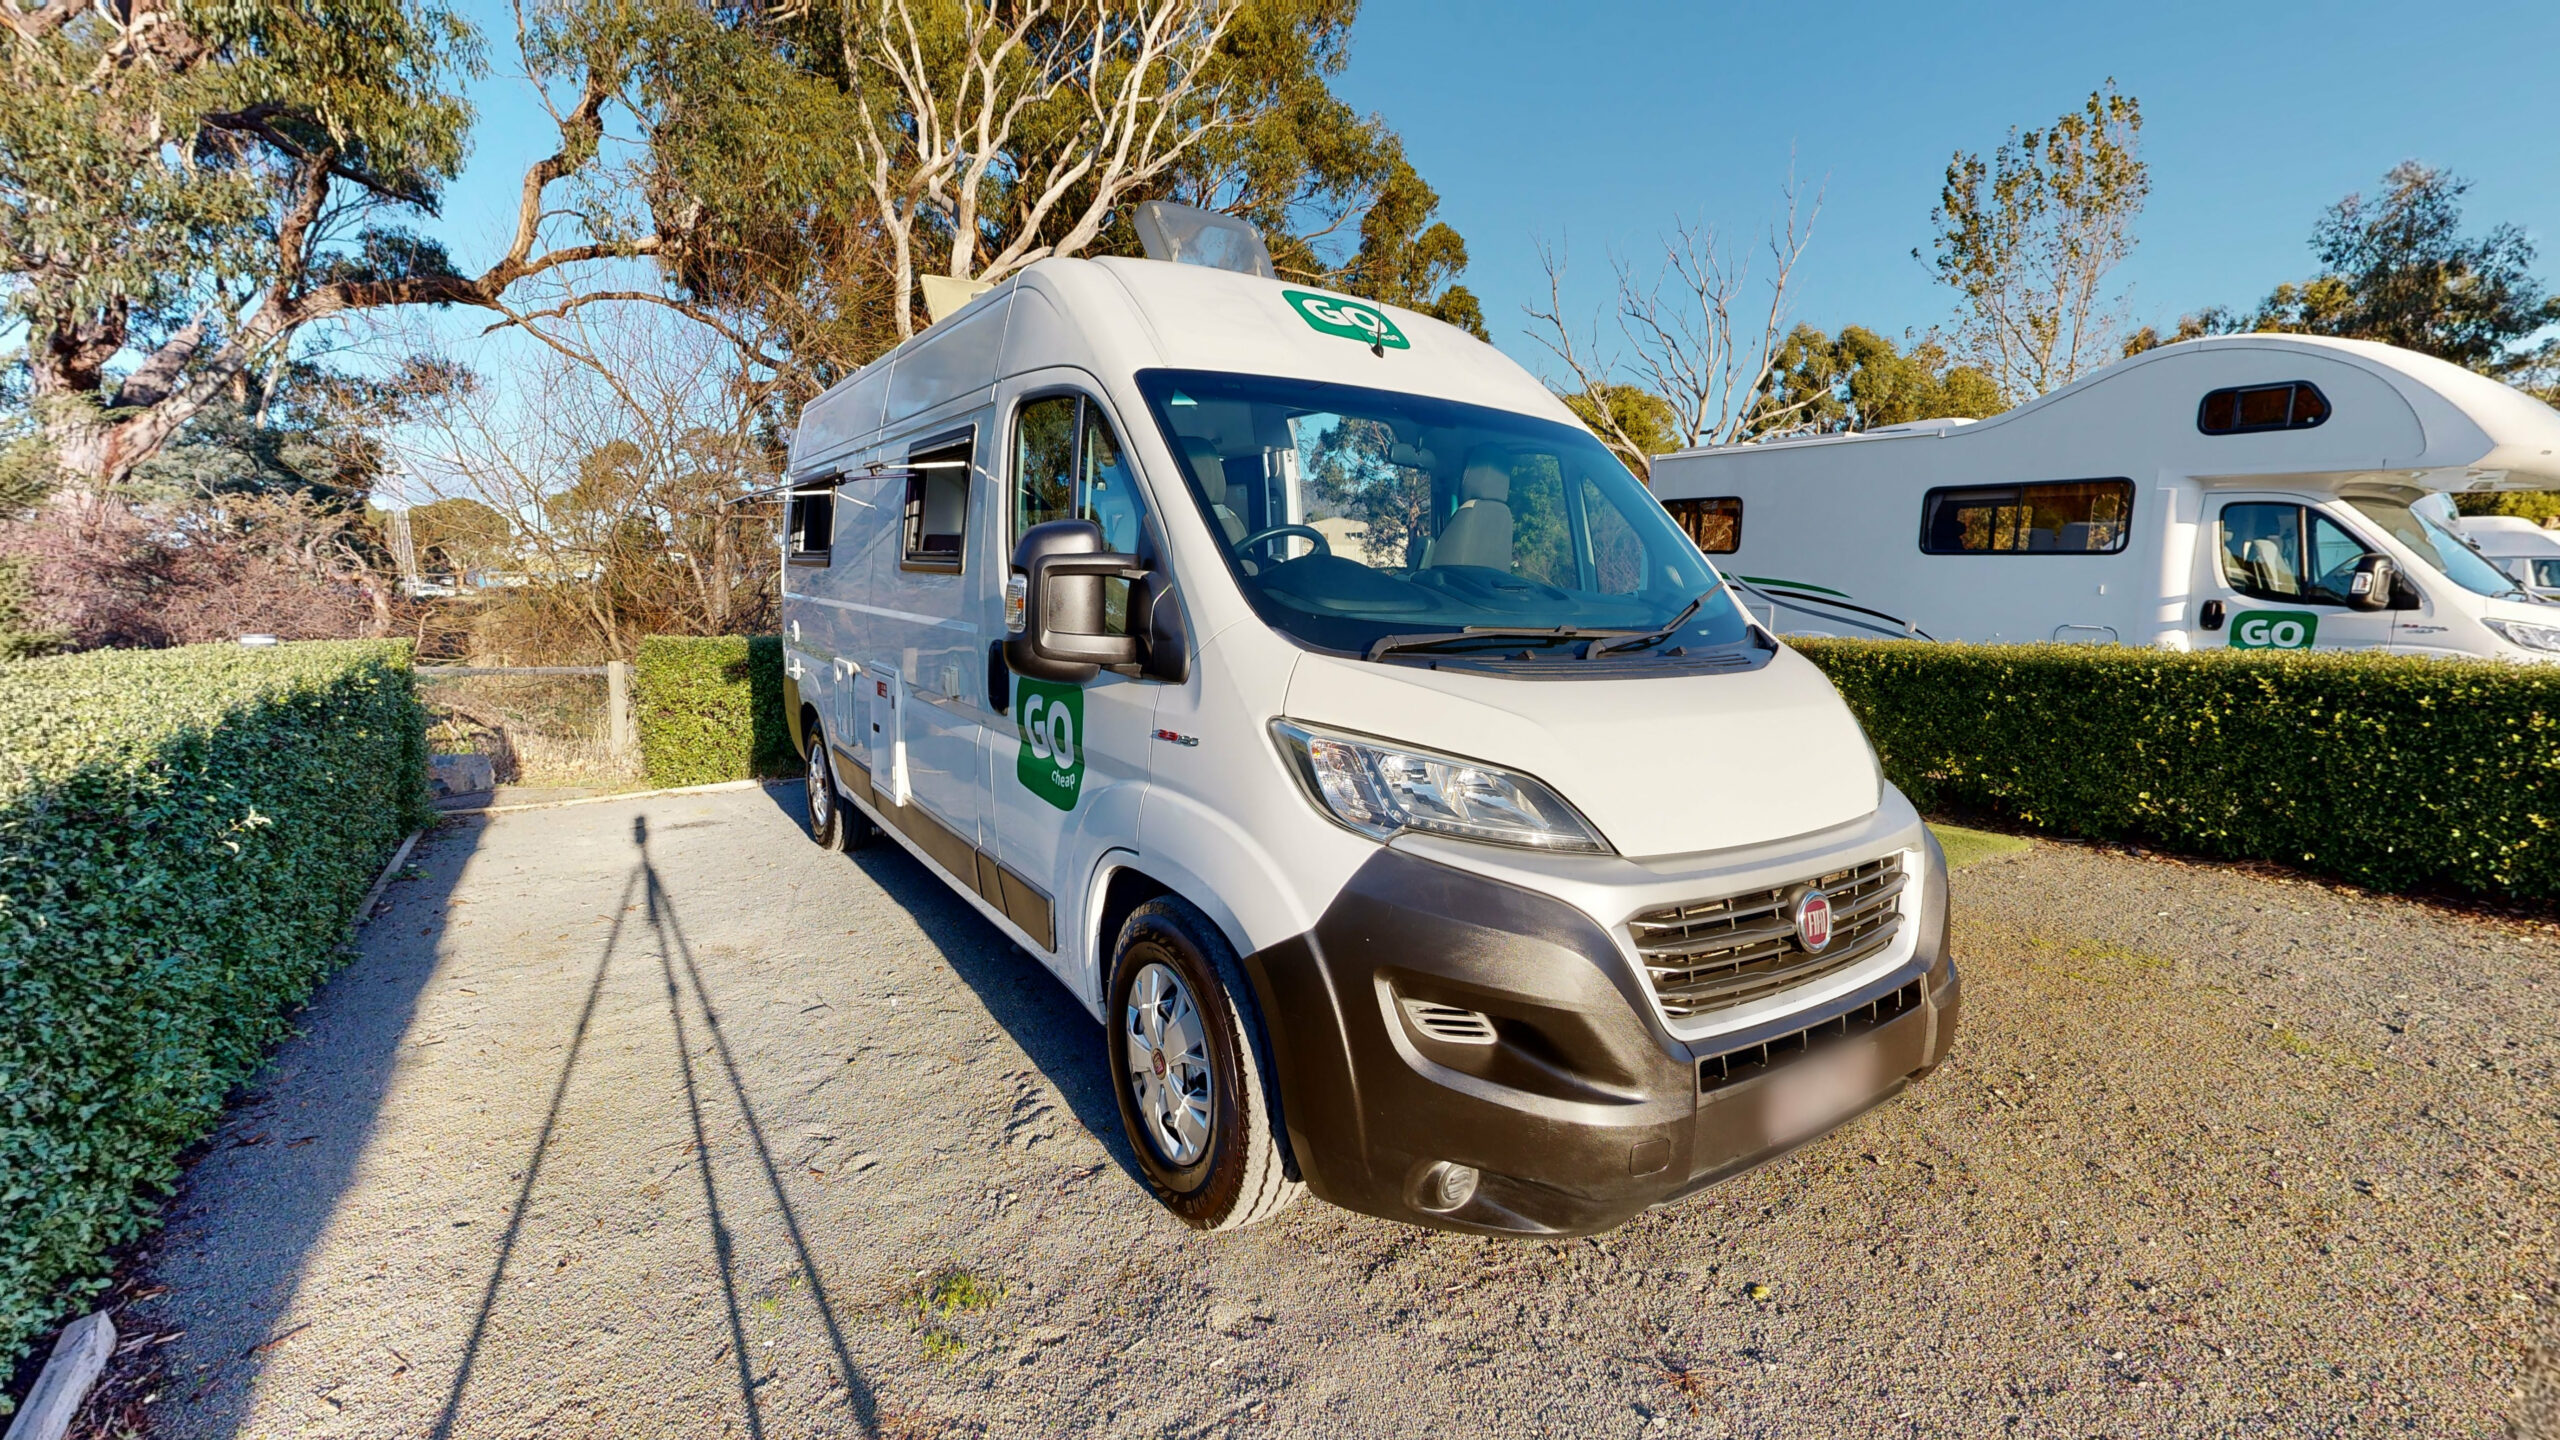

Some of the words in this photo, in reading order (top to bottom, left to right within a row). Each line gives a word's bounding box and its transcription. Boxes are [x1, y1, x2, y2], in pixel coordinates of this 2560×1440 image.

[1301, 298, 1388, 334] GO
[2240, 619, 2305, 648] GO
[1024, 693, 1075, 769] GO
[1051, 769, 1075, 790] cheap
